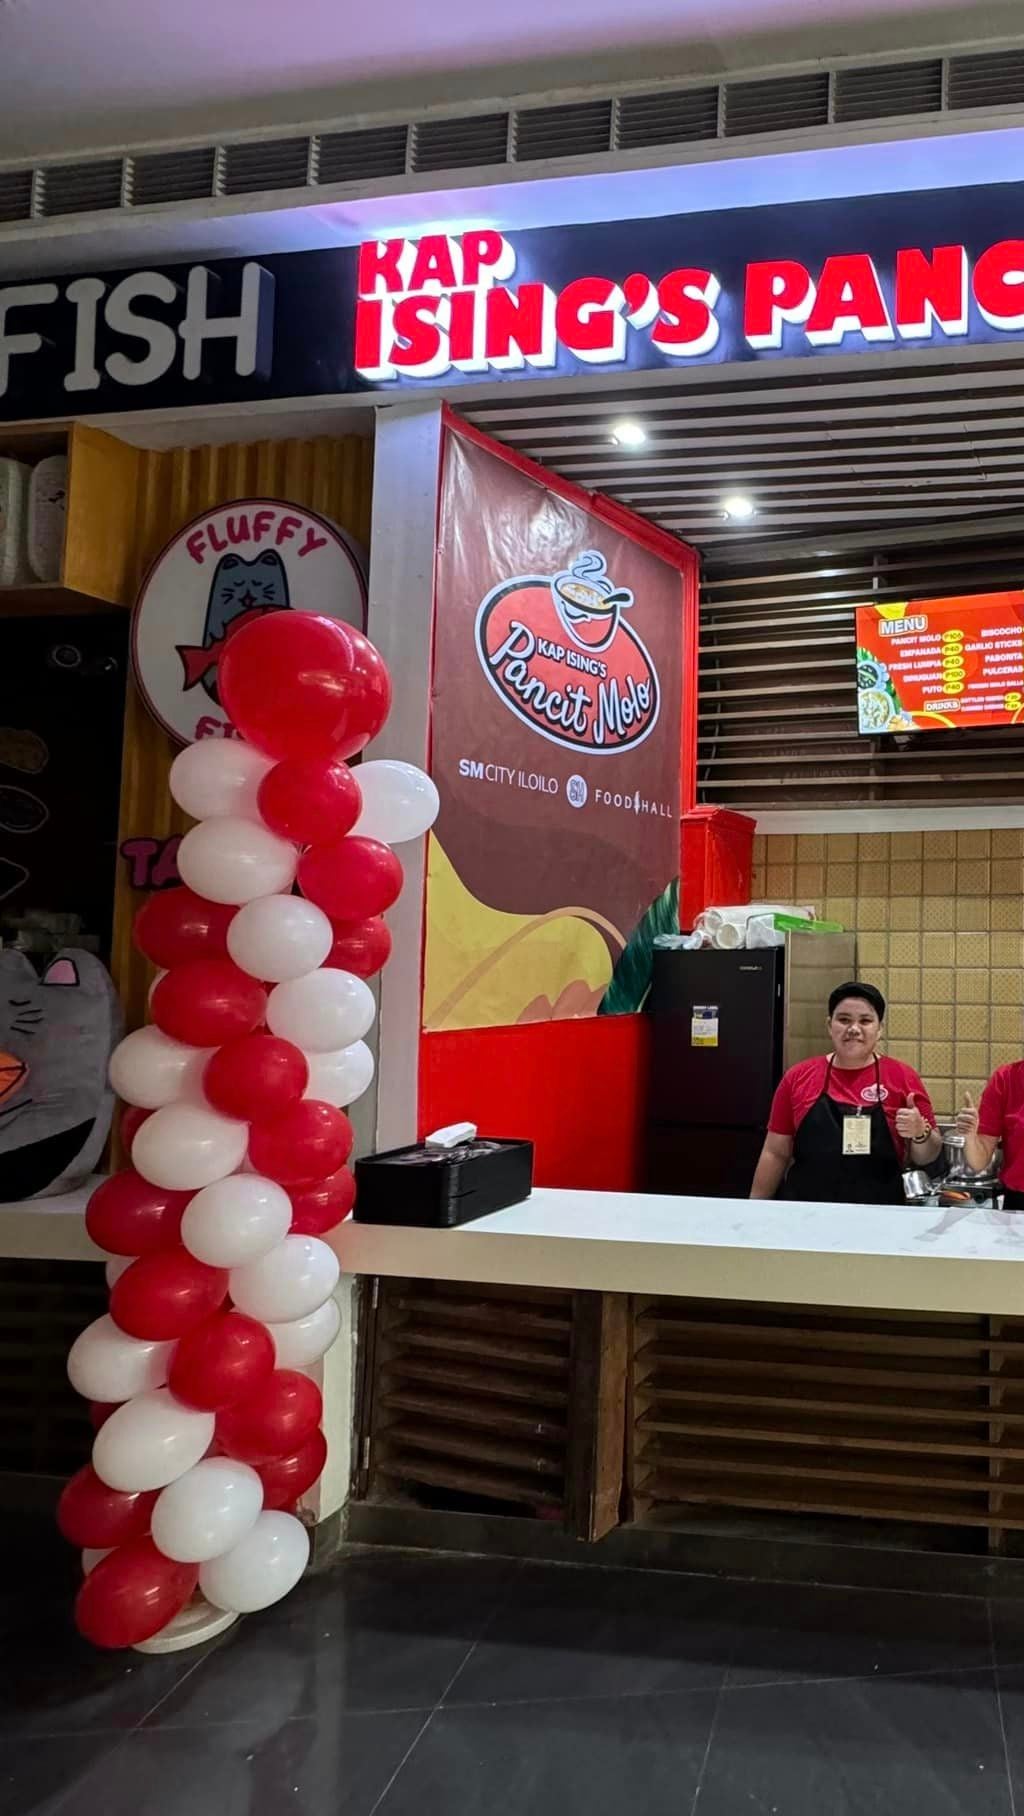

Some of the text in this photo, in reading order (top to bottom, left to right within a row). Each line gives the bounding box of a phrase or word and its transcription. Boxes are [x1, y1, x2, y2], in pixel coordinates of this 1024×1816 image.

[358, 229, 510, 297] KAP
[0, 262, 262, 397] FISH
[355, 269, 718, 378] ISING'S
[187, 511, 327, 564] FLUFFY
[881, 617, 926, 634] MENU
[489, 621, 650, 744] Pancit Molo
[538, 639, 608, 678] KAP ISING'S
[195, 716, 246, 740] FI
[459, 758, 484, 780] SM
[485, 763, 516, 785] CITY
[518, 770, 559, 794] ILOILO
[595, 788, 633, 809] FOOD
[641, 799, 673, 818] HALL
